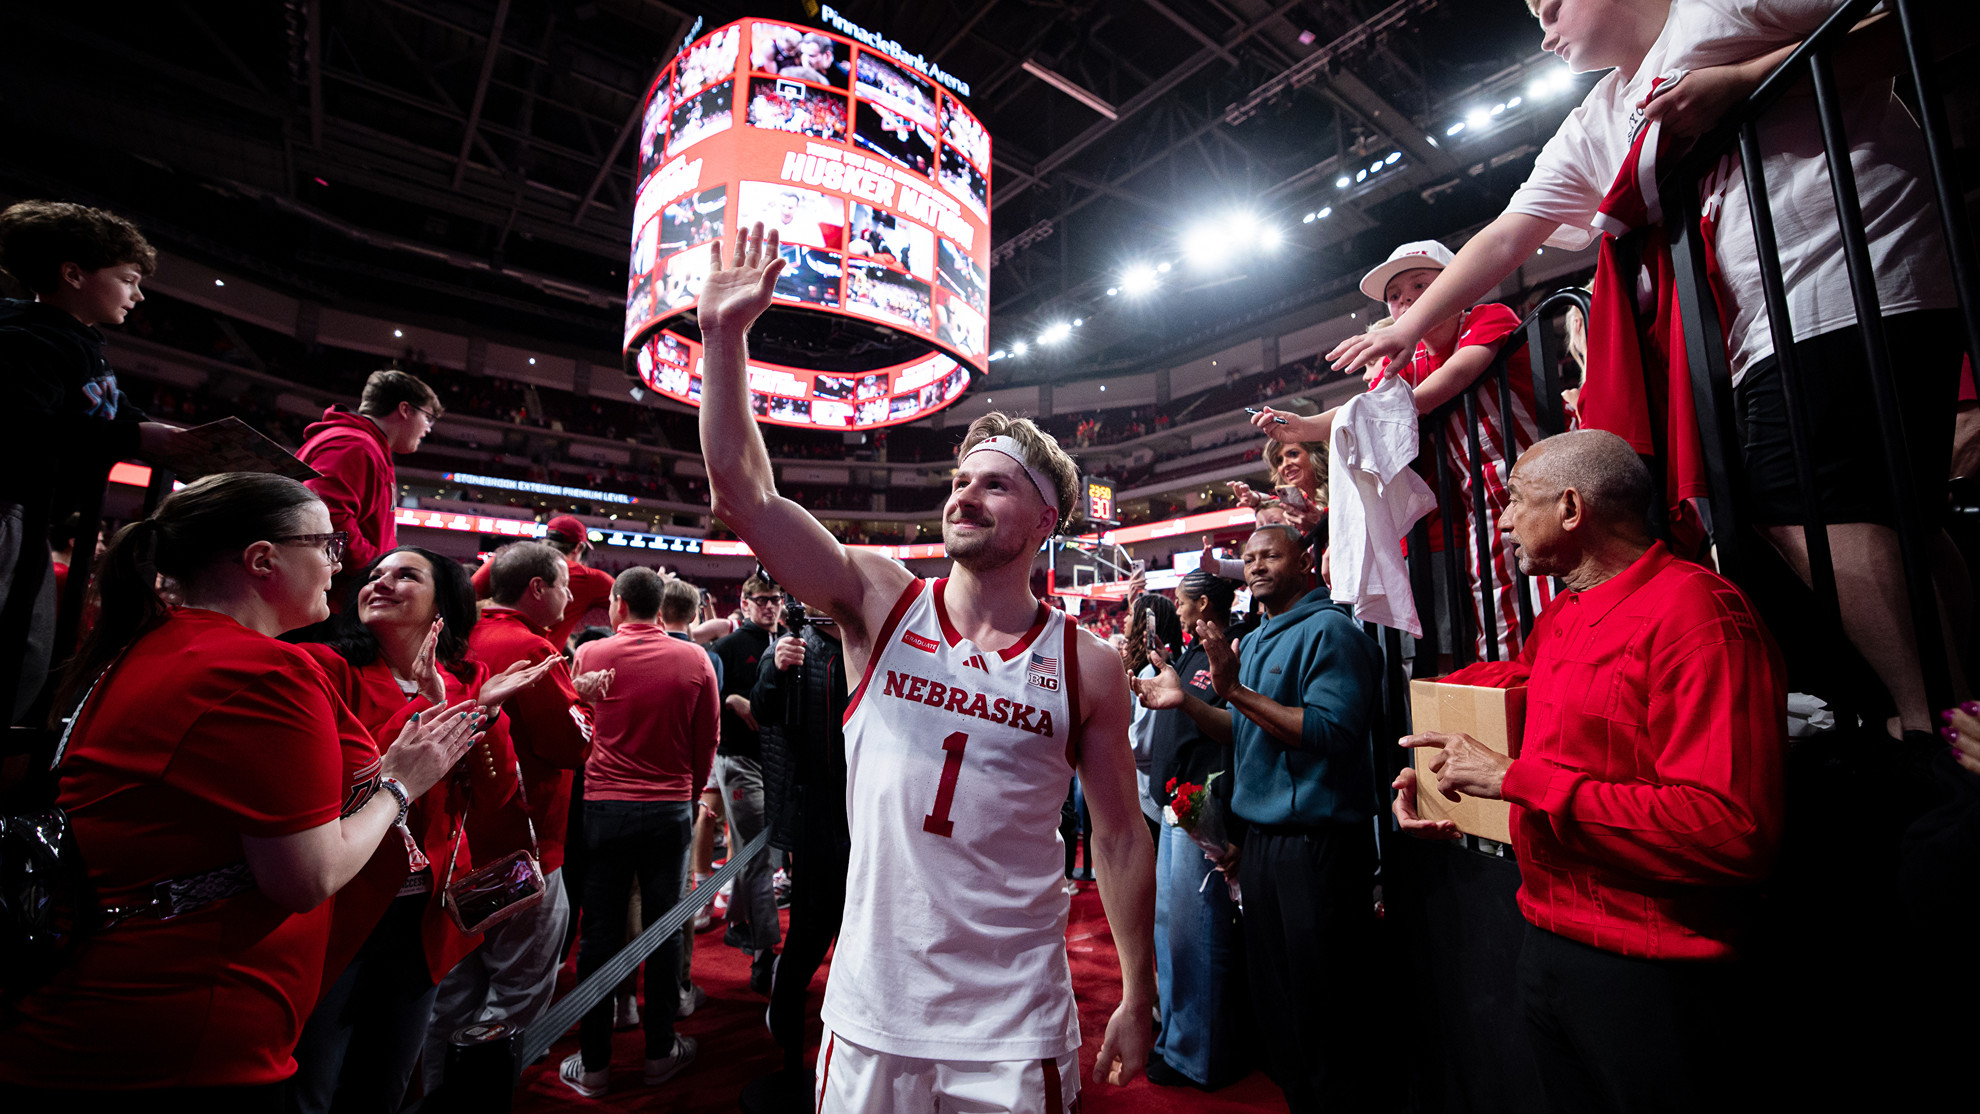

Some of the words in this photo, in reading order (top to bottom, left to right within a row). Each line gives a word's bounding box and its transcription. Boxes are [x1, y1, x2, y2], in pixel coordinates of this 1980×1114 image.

[928, 62, 970, 97] Arena
[780, 151, 895, 208] HUSKER
[453, 472, 517, 490] STONEBROOK
[518, 481, 561, 495] EXTERIOR
[562, 487, 603, 501] PREMIUM
[604, 492, 630, 504] LEVEL
[1089, 484, 1111, 500] 23:50
[1092, 497, 1111, 520] 30
[904, 634, 938, 650] GRADUATE
[883, 670, 1054, 738] NEBRASKA
[732, 788, 743, 800] N
[922, 730, 969, 839] 1
